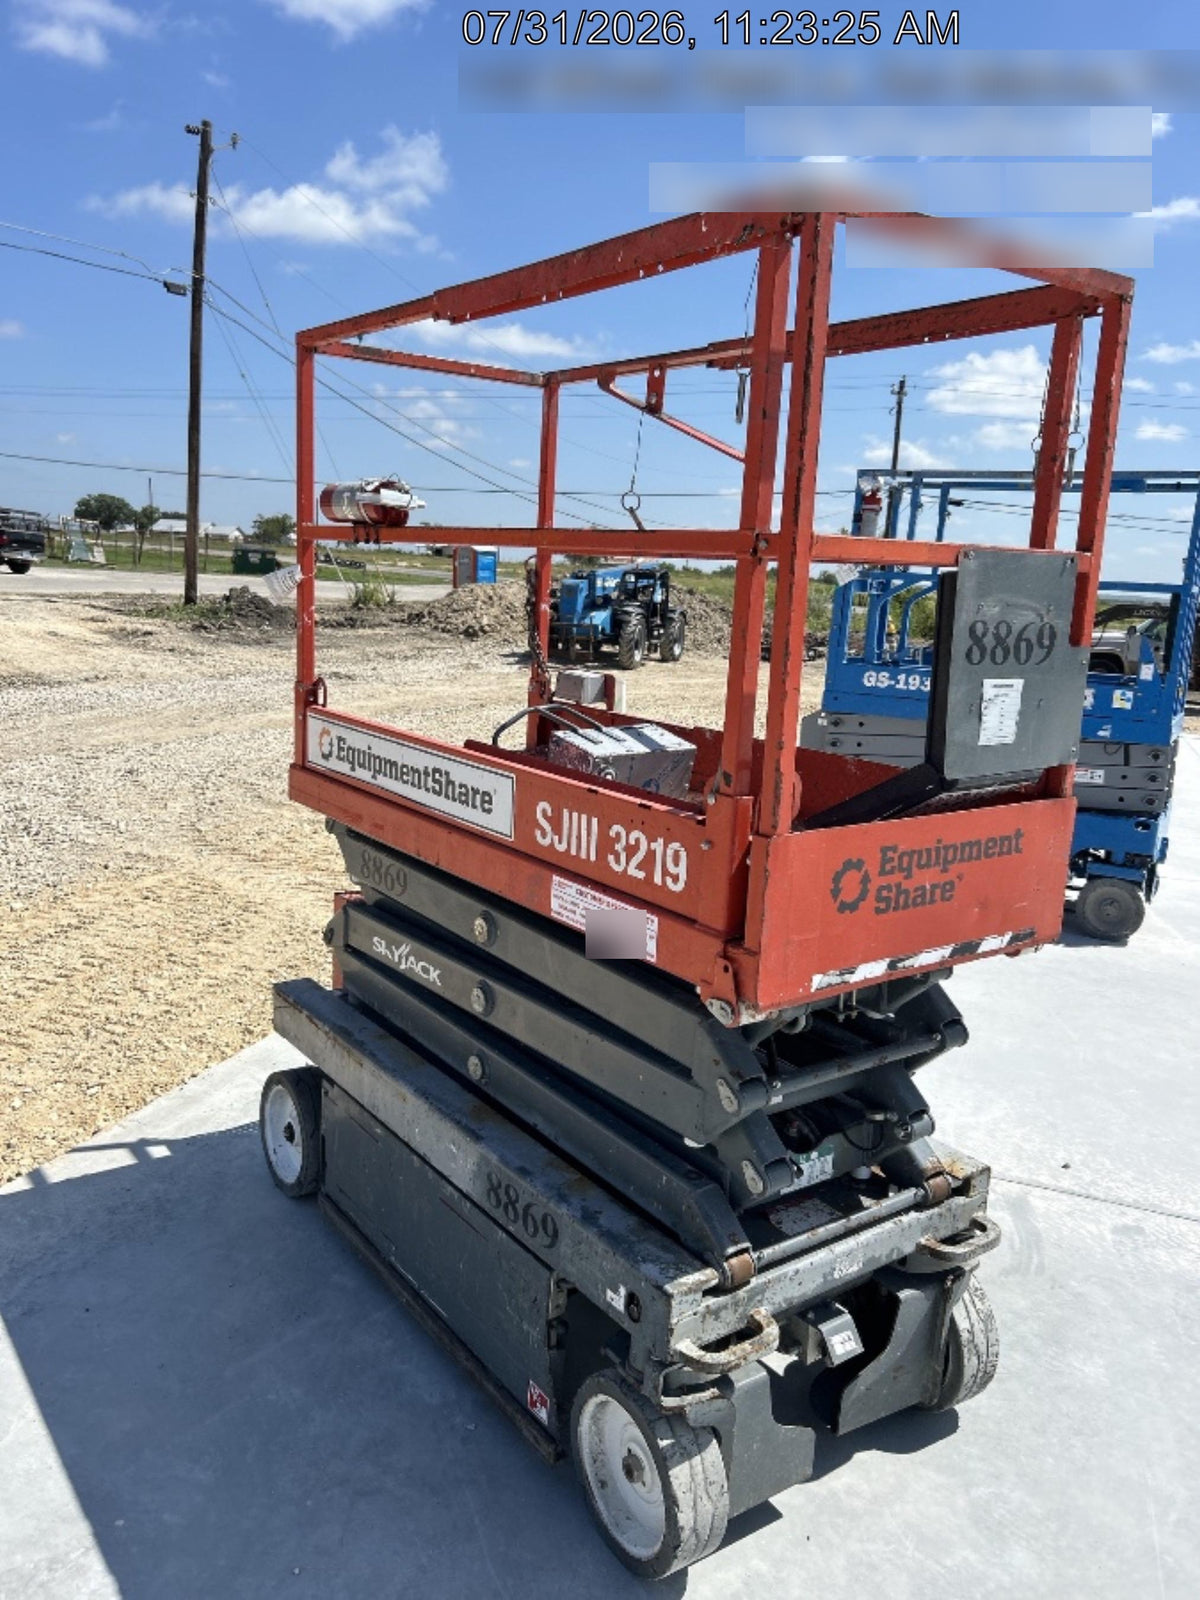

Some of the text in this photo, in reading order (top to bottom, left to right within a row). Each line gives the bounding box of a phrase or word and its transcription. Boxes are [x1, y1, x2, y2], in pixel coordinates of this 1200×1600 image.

[965, 619, 1057, 666] 8869
[336, 735, 494, 815] EquipmentShare
[534, 801, 688, 892] SJIII 3219
[878, 828, 1025, 880] Equipment
[360, 849, 408, 897] 8869
[873, 877, 956, 916] Share
[372, 936, 442, 987] SKYJACK
[486, 1171, 559, 1249] 8869
